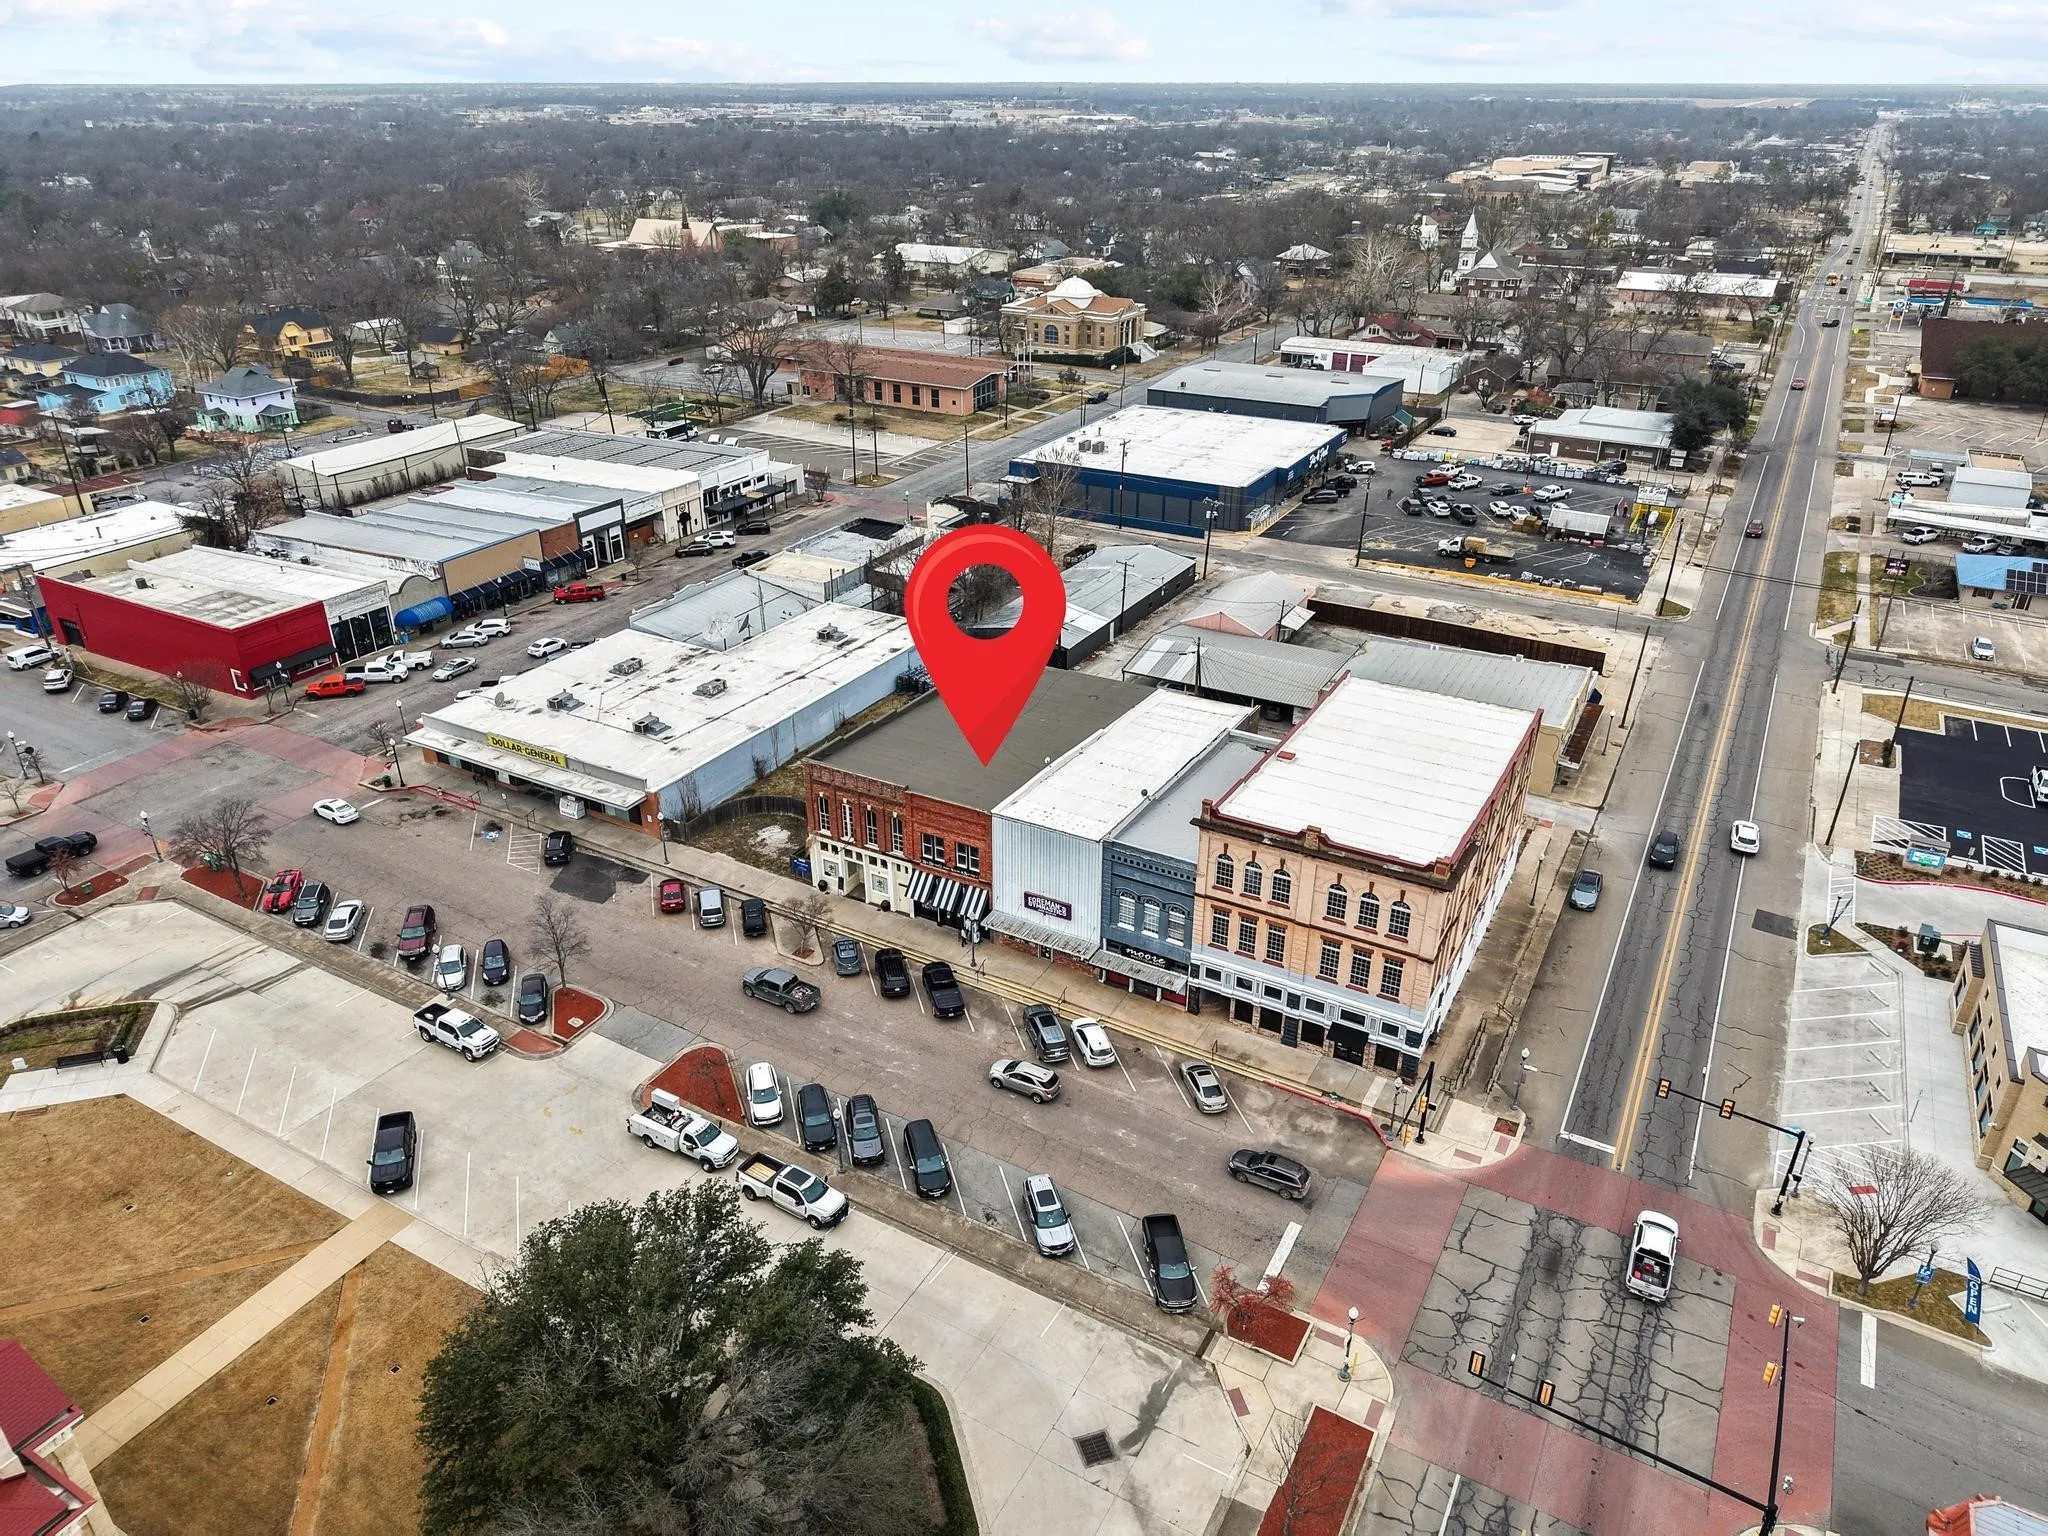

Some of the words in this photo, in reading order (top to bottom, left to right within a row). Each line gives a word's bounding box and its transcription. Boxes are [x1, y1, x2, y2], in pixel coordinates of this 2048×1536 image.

[491, 736, 523, 754] DOLLAR
[524, 747, 561, 765] GENERAL
[1028, 901, 1067, 917] GYMNASTICS
[1967, 1281, 1979, 1315] OPEN
